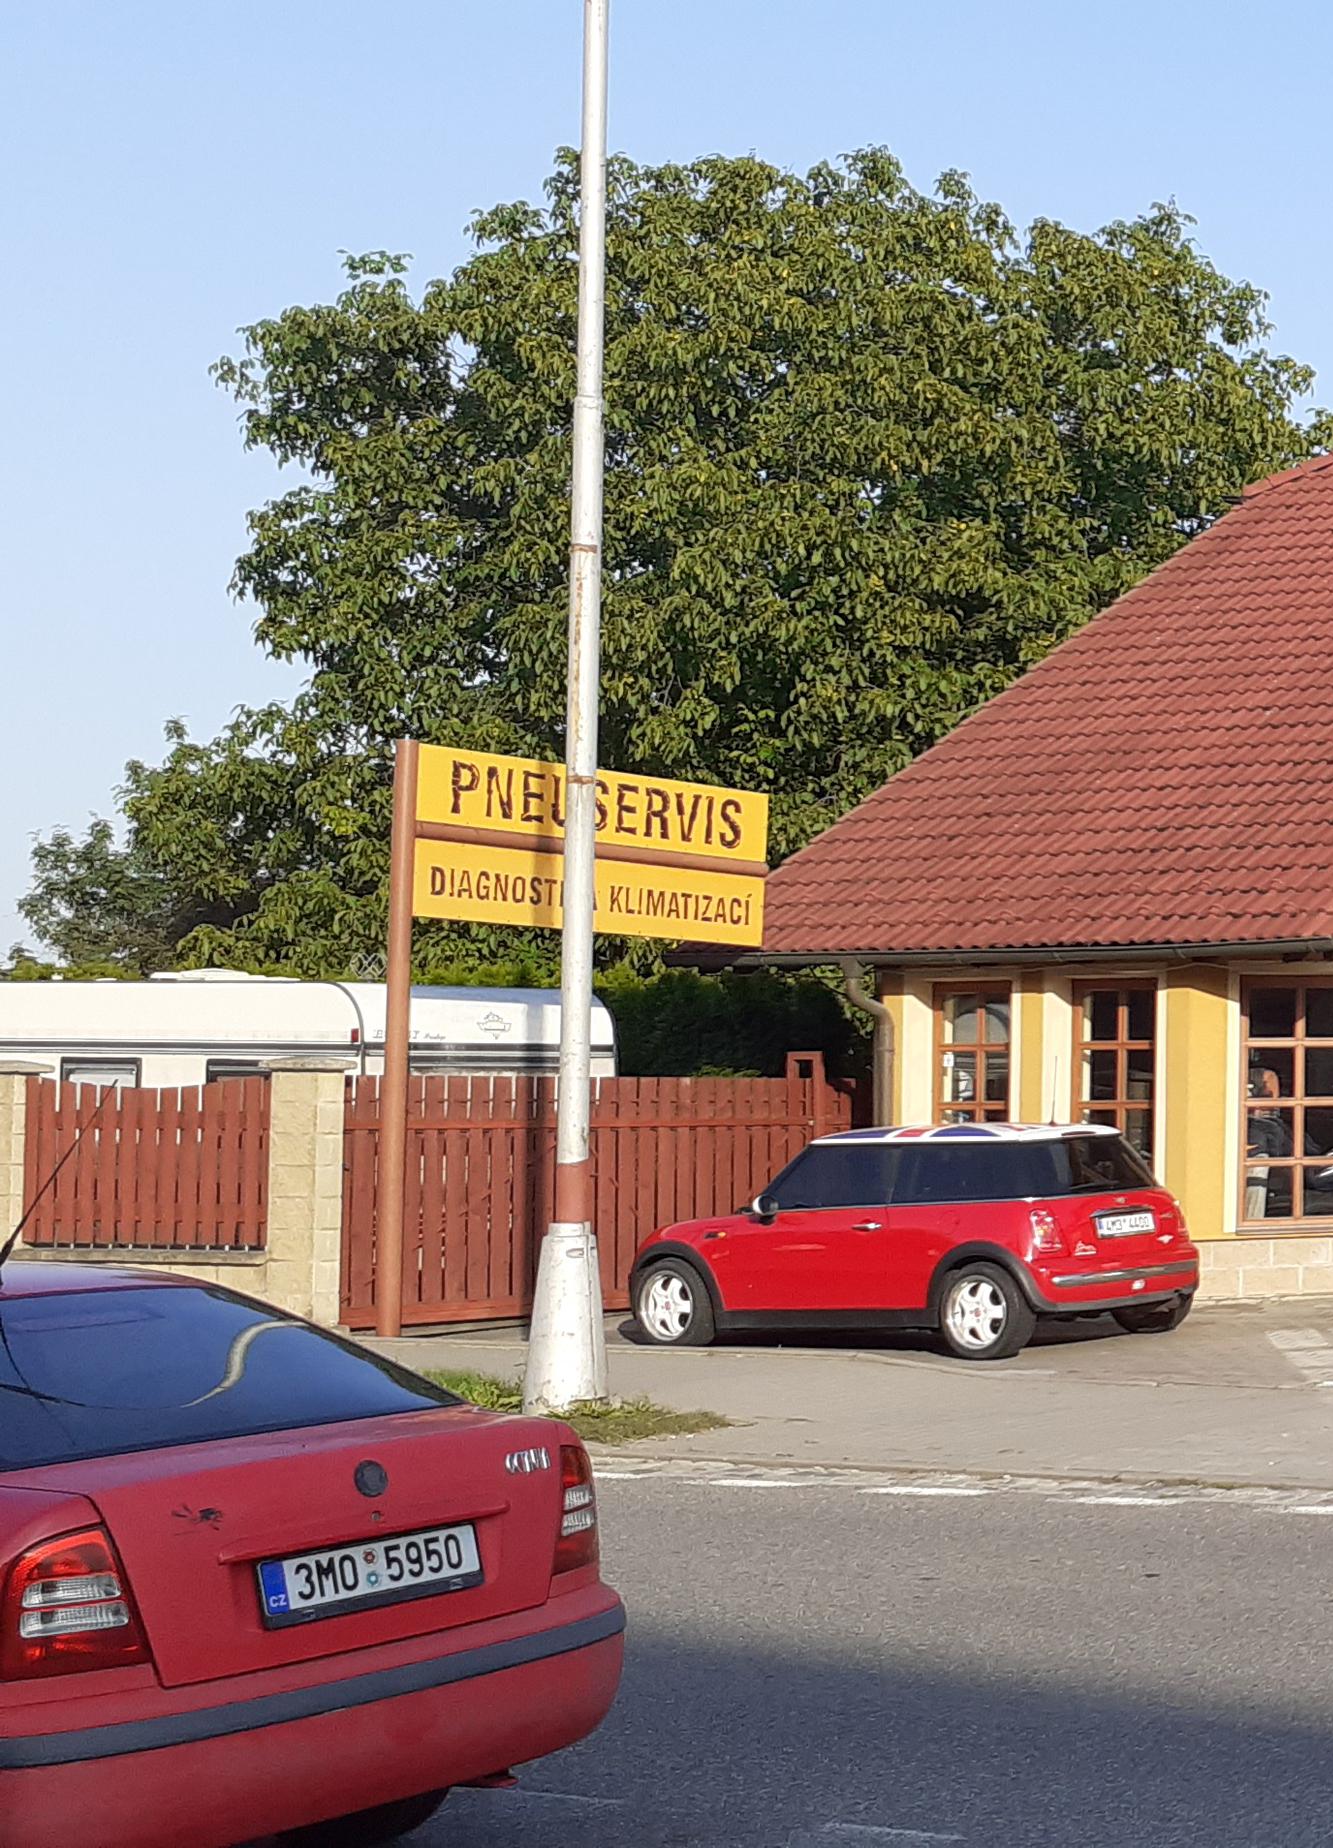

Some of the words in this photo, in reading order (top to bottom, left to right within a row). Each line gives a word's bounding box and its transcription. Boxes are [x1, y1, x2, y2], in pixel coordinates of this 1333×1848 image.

[430, 866, 597, 910] DIAGNOSTI
[609, 884, 751, 926] KLIMATIZACÍ
[269, 1594, 287, 1608] CZ
[383, 1534, 462, 1581] 5950
